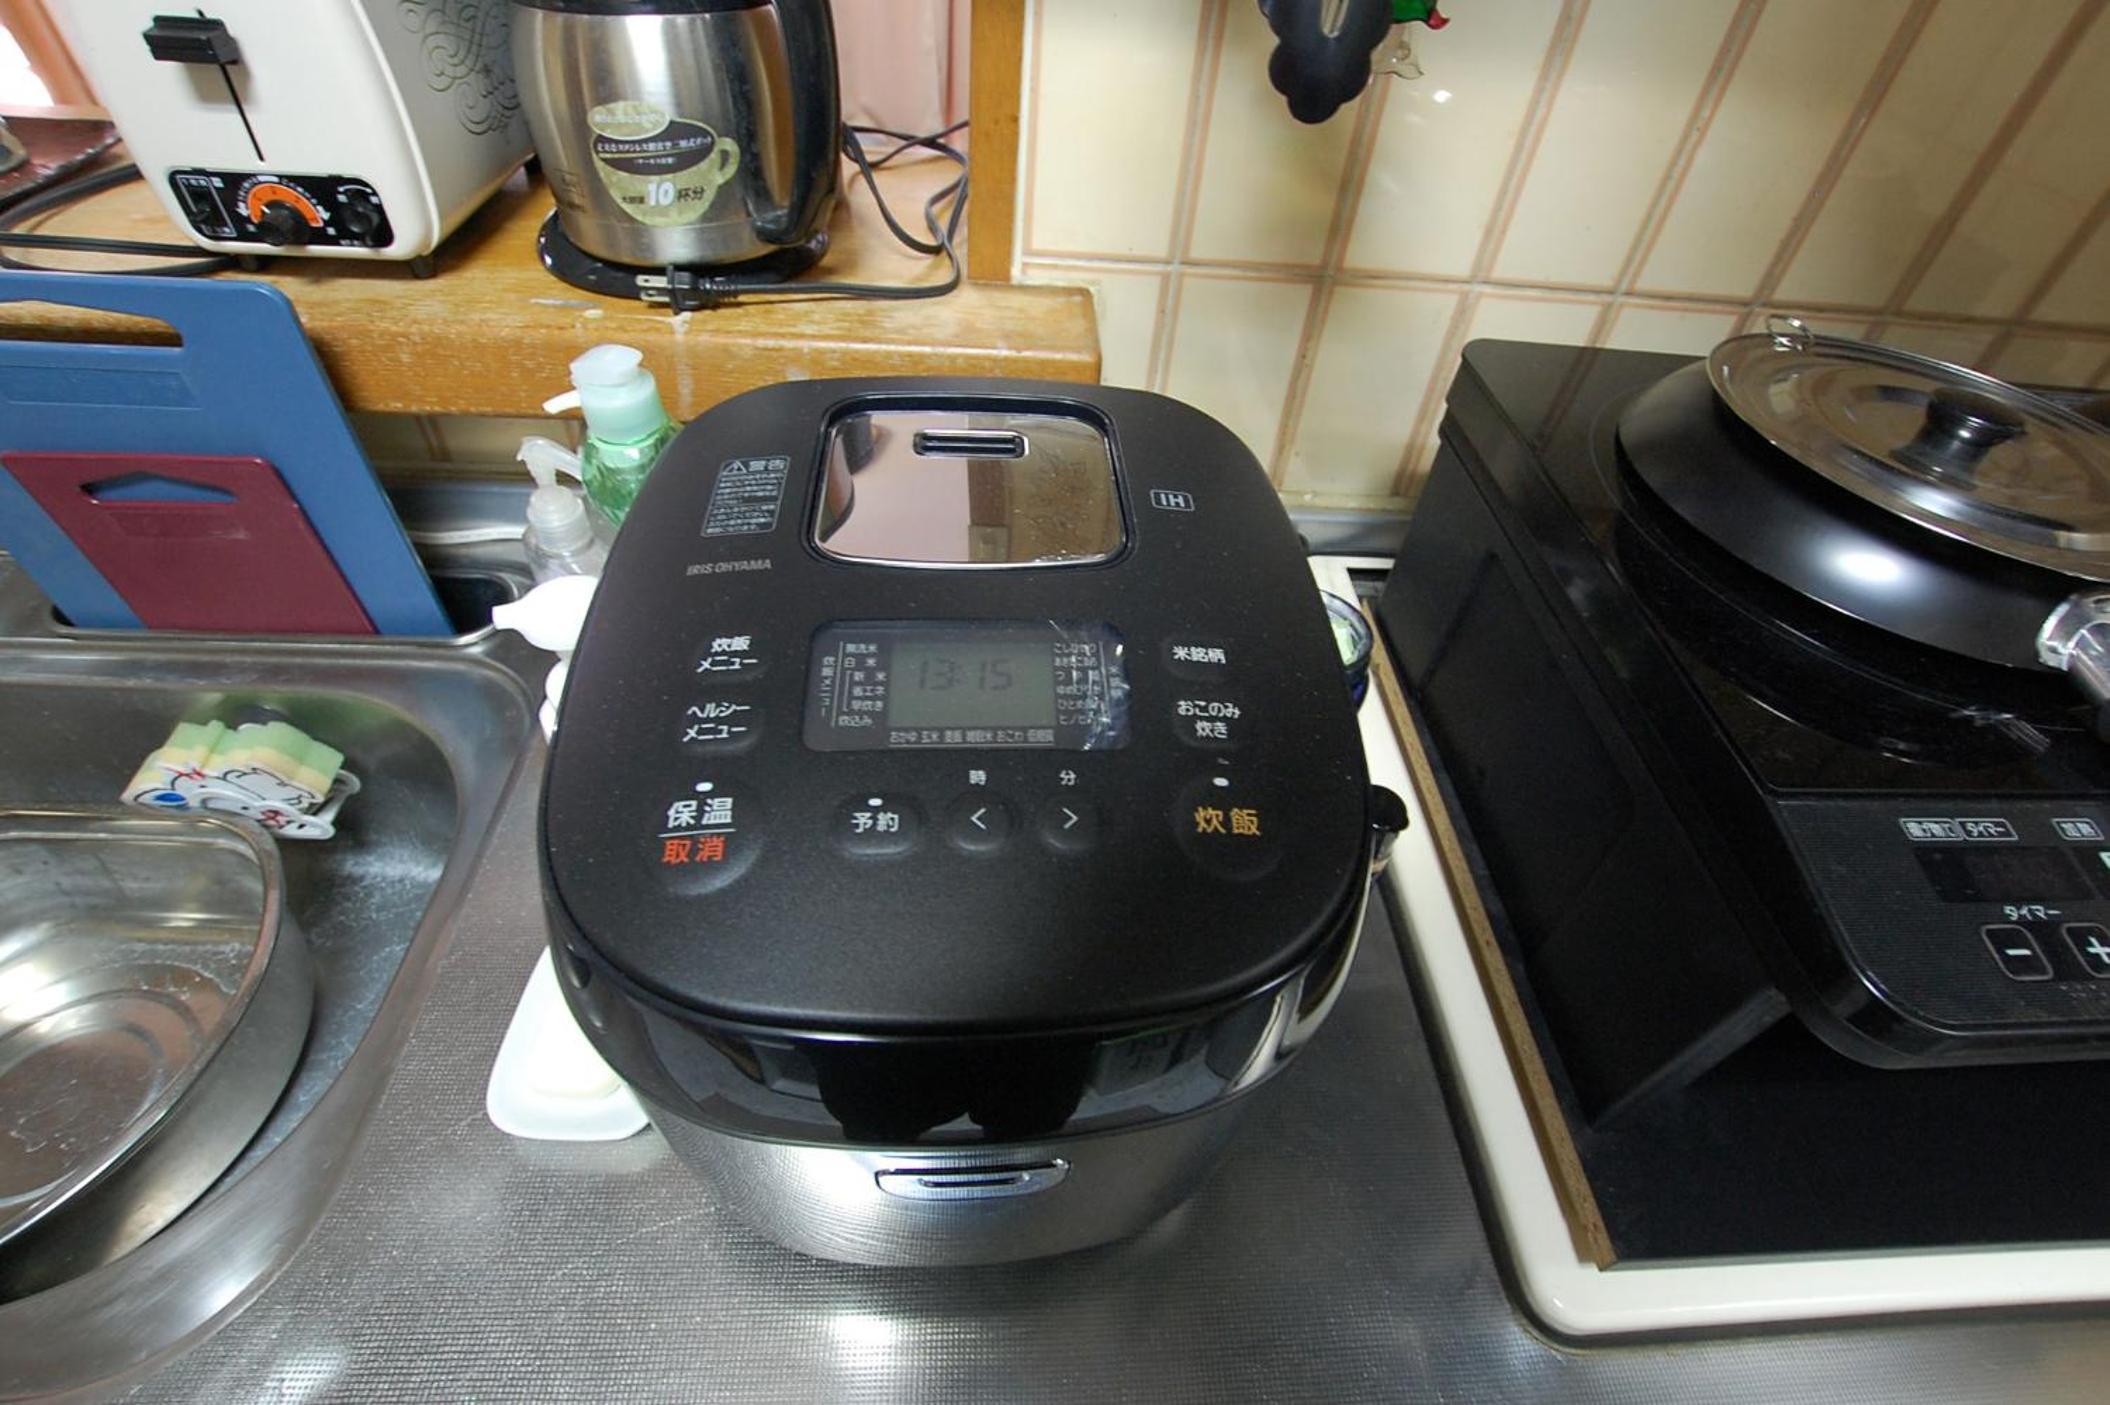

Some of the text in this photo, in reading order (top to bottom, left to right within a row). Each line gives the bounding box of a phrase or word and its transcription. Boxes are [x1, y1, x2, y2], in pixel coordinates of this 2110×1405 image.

[646, 181, 675, 206] 10
[677, 186, 705, 203] 杯分
[1159, 493, 1186, 508] IH
[686, 559, 772, 576] IRIS OHYAMA
[711, 636, 752, 653] 炊飯
[1172, 645, 1226, 664] 米銘柄
[696, 656, 758, 673] メニュー
[686, 702, 751, 718] ヘルシー
[1177, 700, 1241, 719] おこのみ
[682, 724, 748, 742] メニュー
[1195, 720, 1228, 739] 炊き
[969, 770, 987, 786] 時
[1059, 769, 1077, 786] 分
[666, 797, 733, 828] 保温
[1194, 806, 1261, 836] 炊飯
[851, 811, 900, 833] 予約
[1965, 822, 2006, 838] タイマー
[661, 834, 726, 865] 取消
[2003, 904, 2062, 921] タイマー
